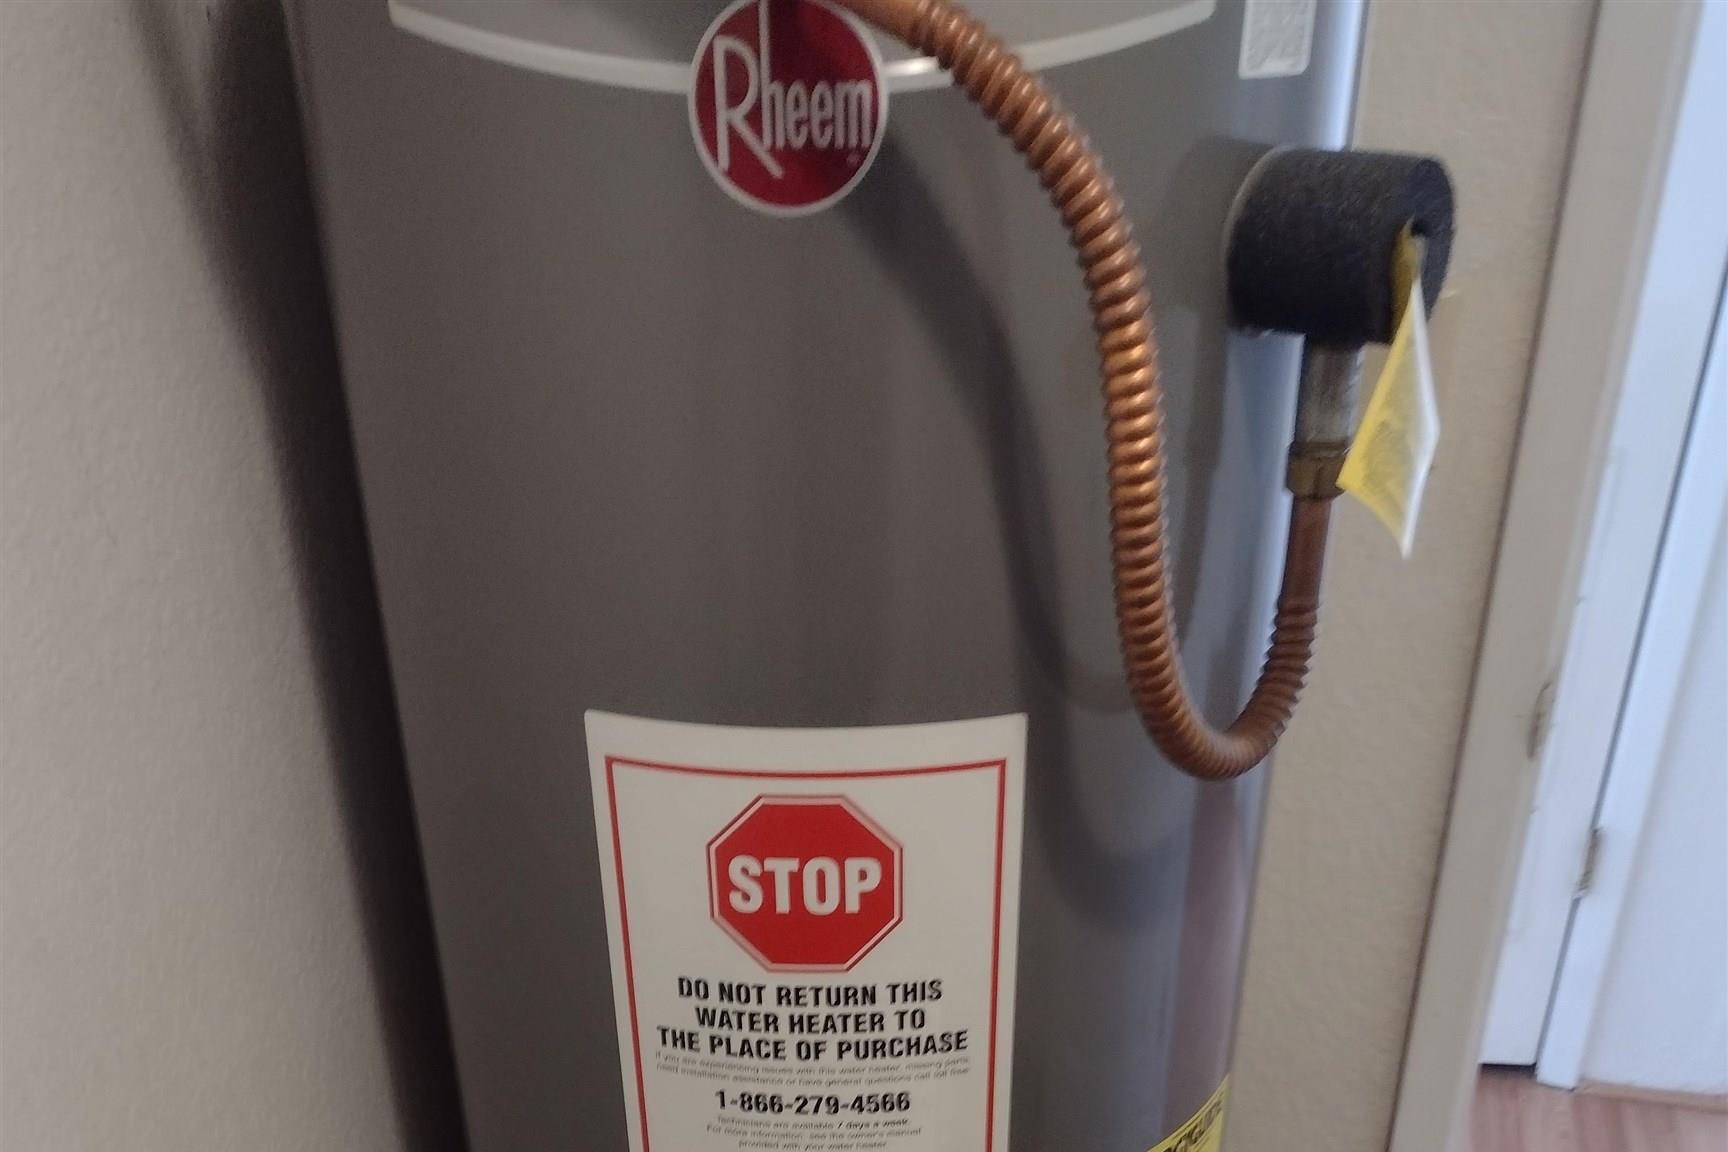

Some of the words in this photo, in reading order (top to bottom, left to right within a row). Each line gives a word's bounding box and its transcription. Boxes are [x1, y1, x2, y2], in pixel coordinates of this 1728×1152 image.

[713, 0, 873, 179] Rheem
[728, 854, 883, 915] STOP
[678, 976, 709, 1000] DO
[718, 981, 766, 1006] NOT
[776, 984, 877, 1008] RETURN
[886, 978, 942, 1005] THIS
[695, 1006, 779, 1033] WATER
[788, 1012, 885, 1035] HEATER
[895, 1008, 925, 1031] TO
[656, 1025, 701, 1052] THE
[709, 1034, 787, 1060] PLACE
[796, 1040, 827, 1061] OF
[836, 1029, 969, 1061] PURCHASE
[714, 1089, 910, 1116] 1-866-279-4566
